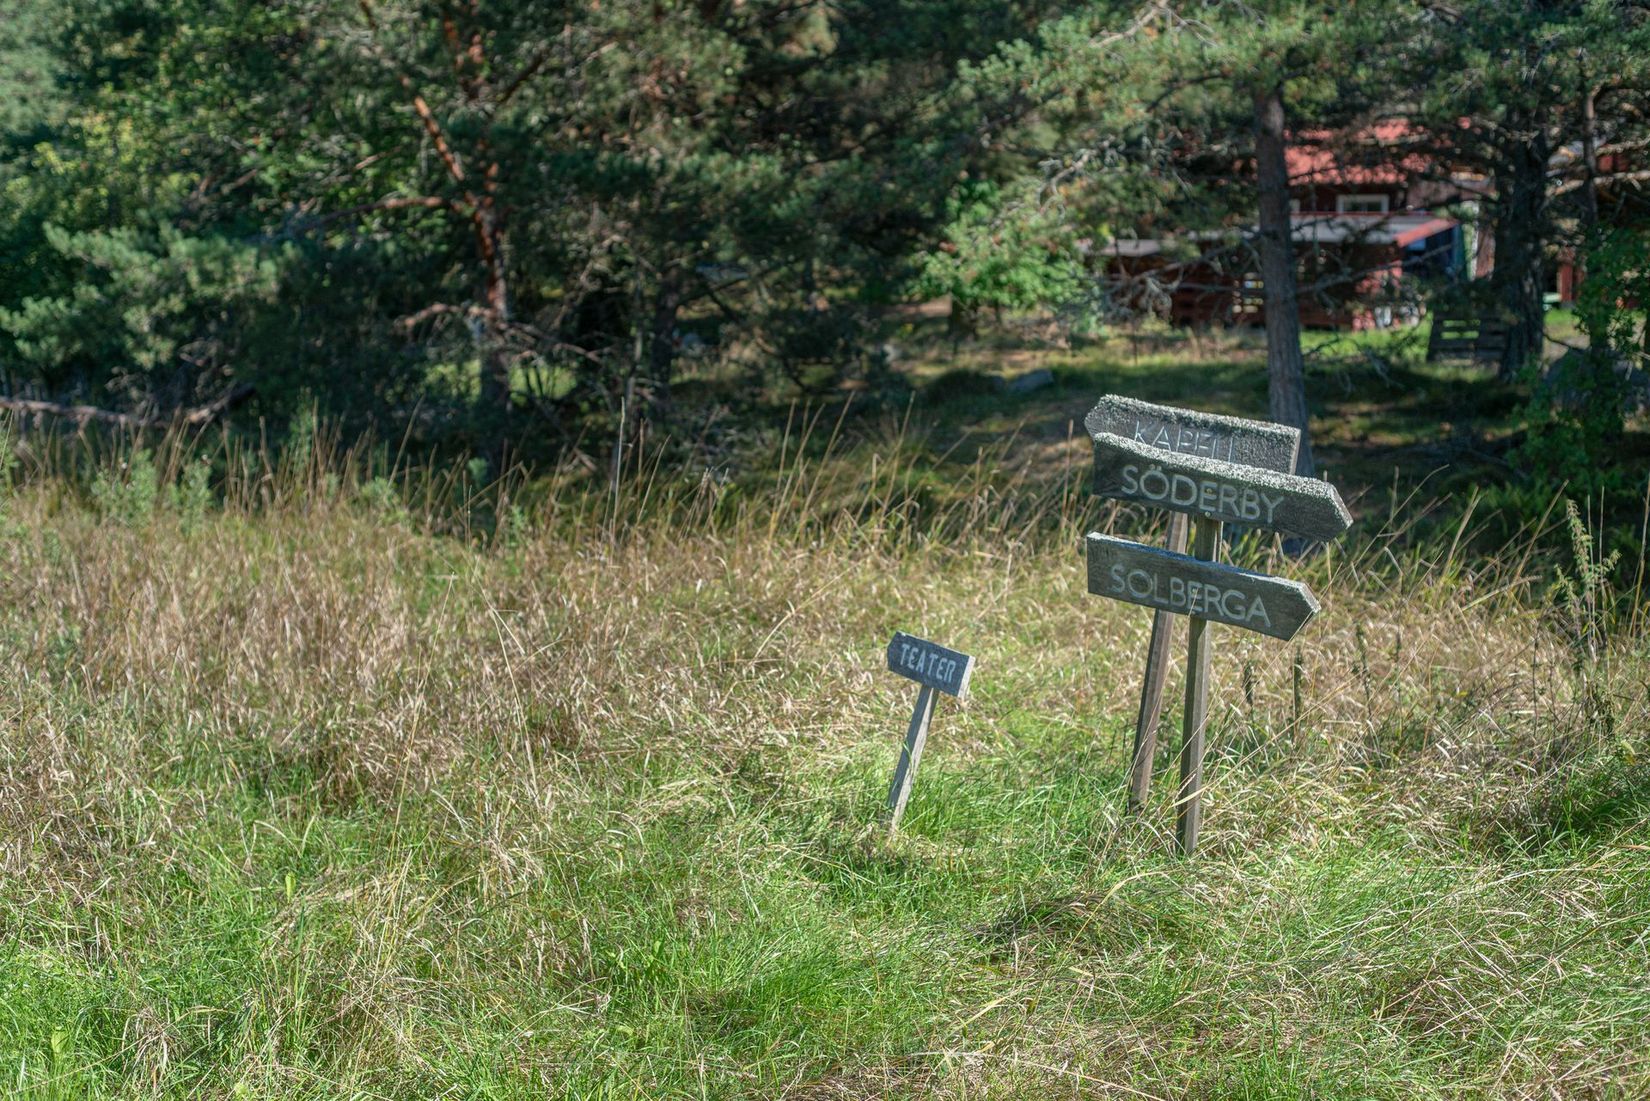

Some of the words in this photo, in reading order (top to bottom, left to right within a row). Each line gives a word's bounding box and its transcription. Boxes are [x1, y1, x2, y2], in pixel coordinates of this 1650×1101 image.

[1120, 463, 1284, 524] SÖDERBY
[1110, 563, 1271, 627] SOLBERGA
[900, 643, 956, 683] TEATER
